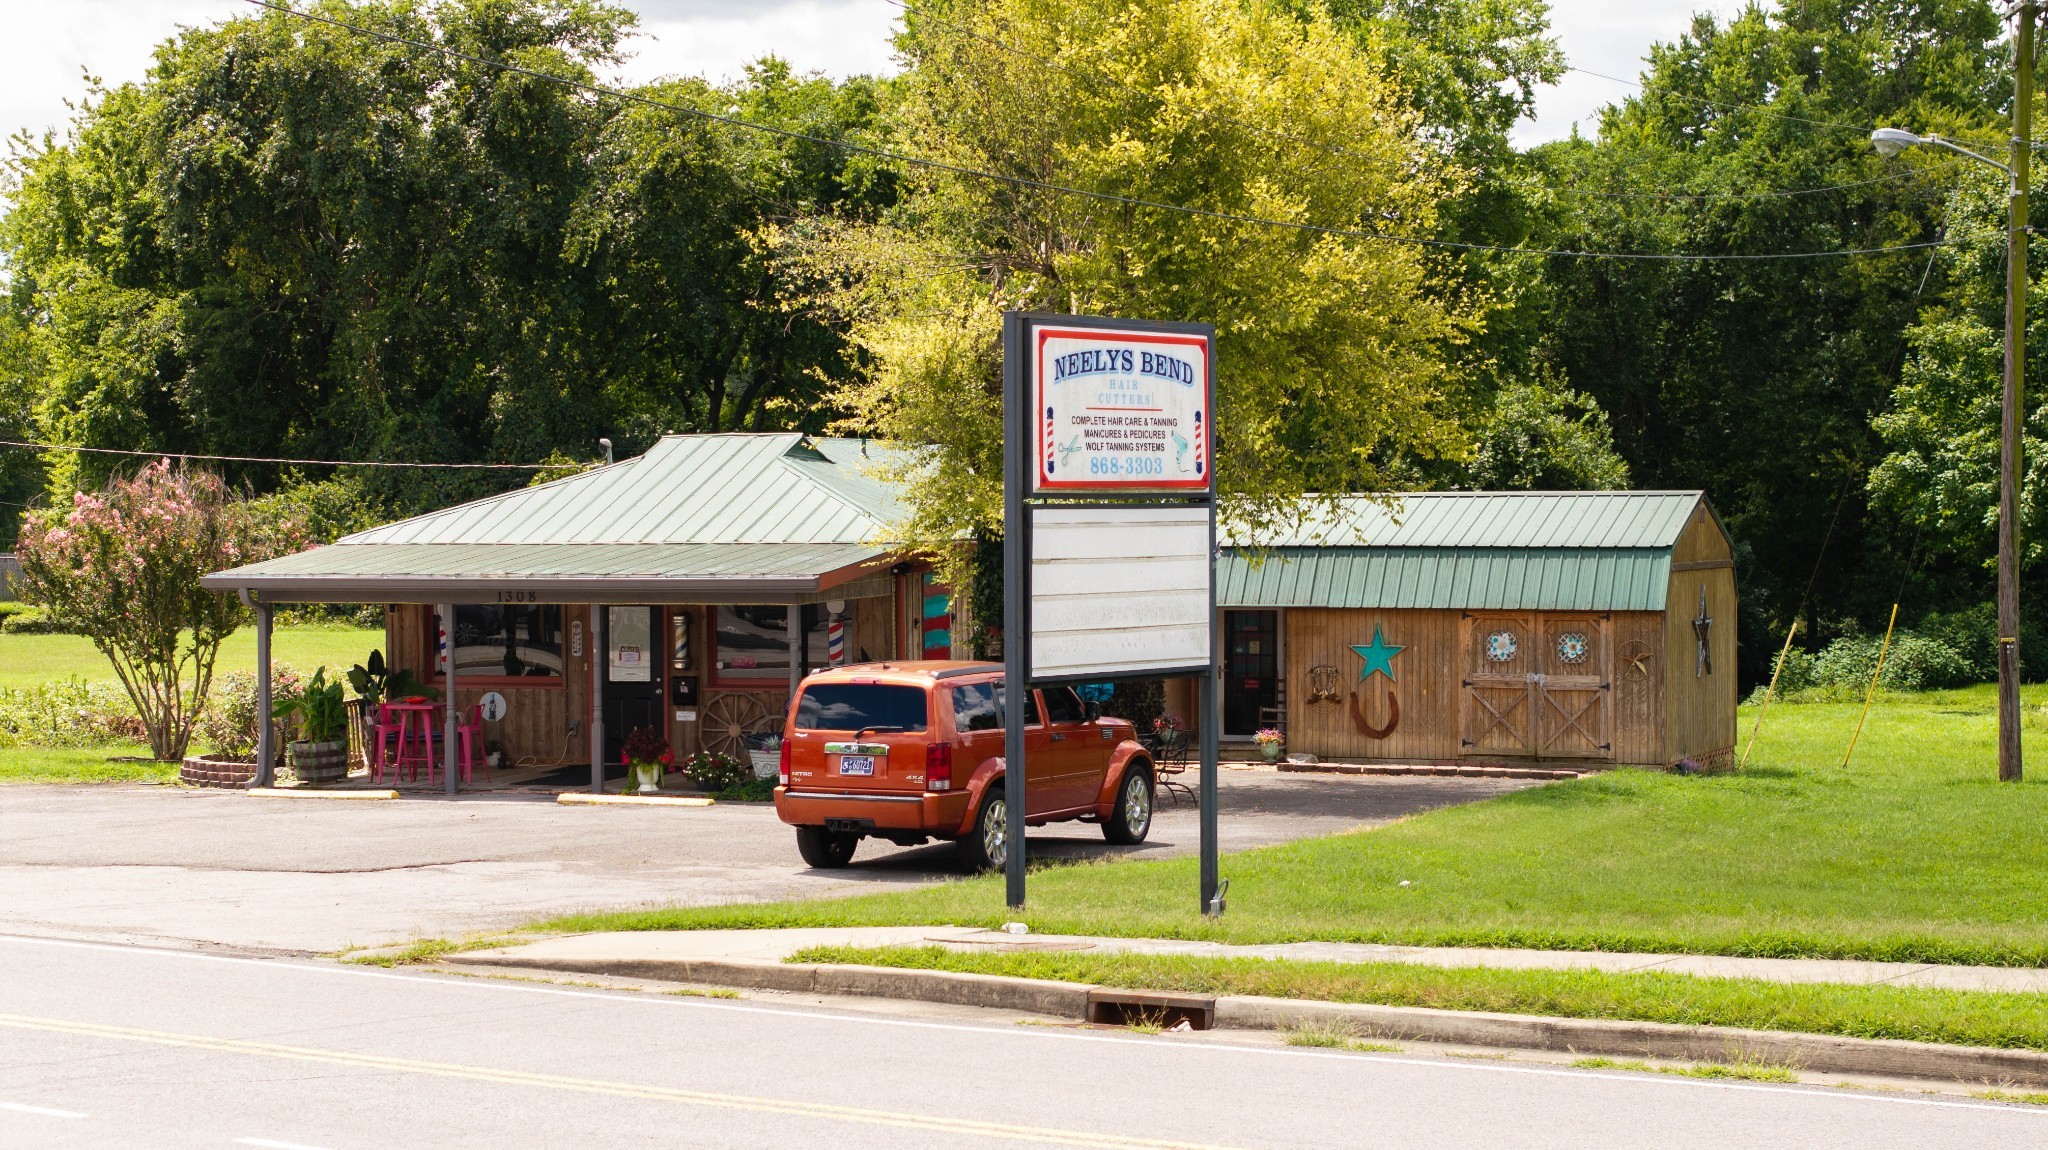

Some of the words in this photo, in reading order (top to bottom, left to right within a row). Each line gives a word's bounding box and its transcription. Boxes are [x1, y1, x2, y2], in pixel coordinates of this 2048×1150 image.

[1054, 349, 1133, 382] NEELYS
[1140, 351, 1194, 386] BEND
[1109, 379, 1138, 390] HAIR
[1098, 393, 1150, 405] CUTTERS
[1071, 416, 1106, 426] COMPLETE
[1107, 417, 1123, 426] HAIR
[1124, 417, 1143, 427] CARE
[1144, 418, 1149, 426] &
[1150, 418, 1178, 427] TANNING
[1084, 429, 1122, 439] MANICURES
[1123, 430, 1128, 438] &
[1129, 430, 1166, 439] PEDICURES
[1086, 442, 1104, 451] WOLF
[1106, 442, 1134, 452] TANNING
[1136, 443, 1165, 452] SYSTEMS
[1090, 457, 1163, 475] 868-3303
[497, 591, 537, 603] 1308
